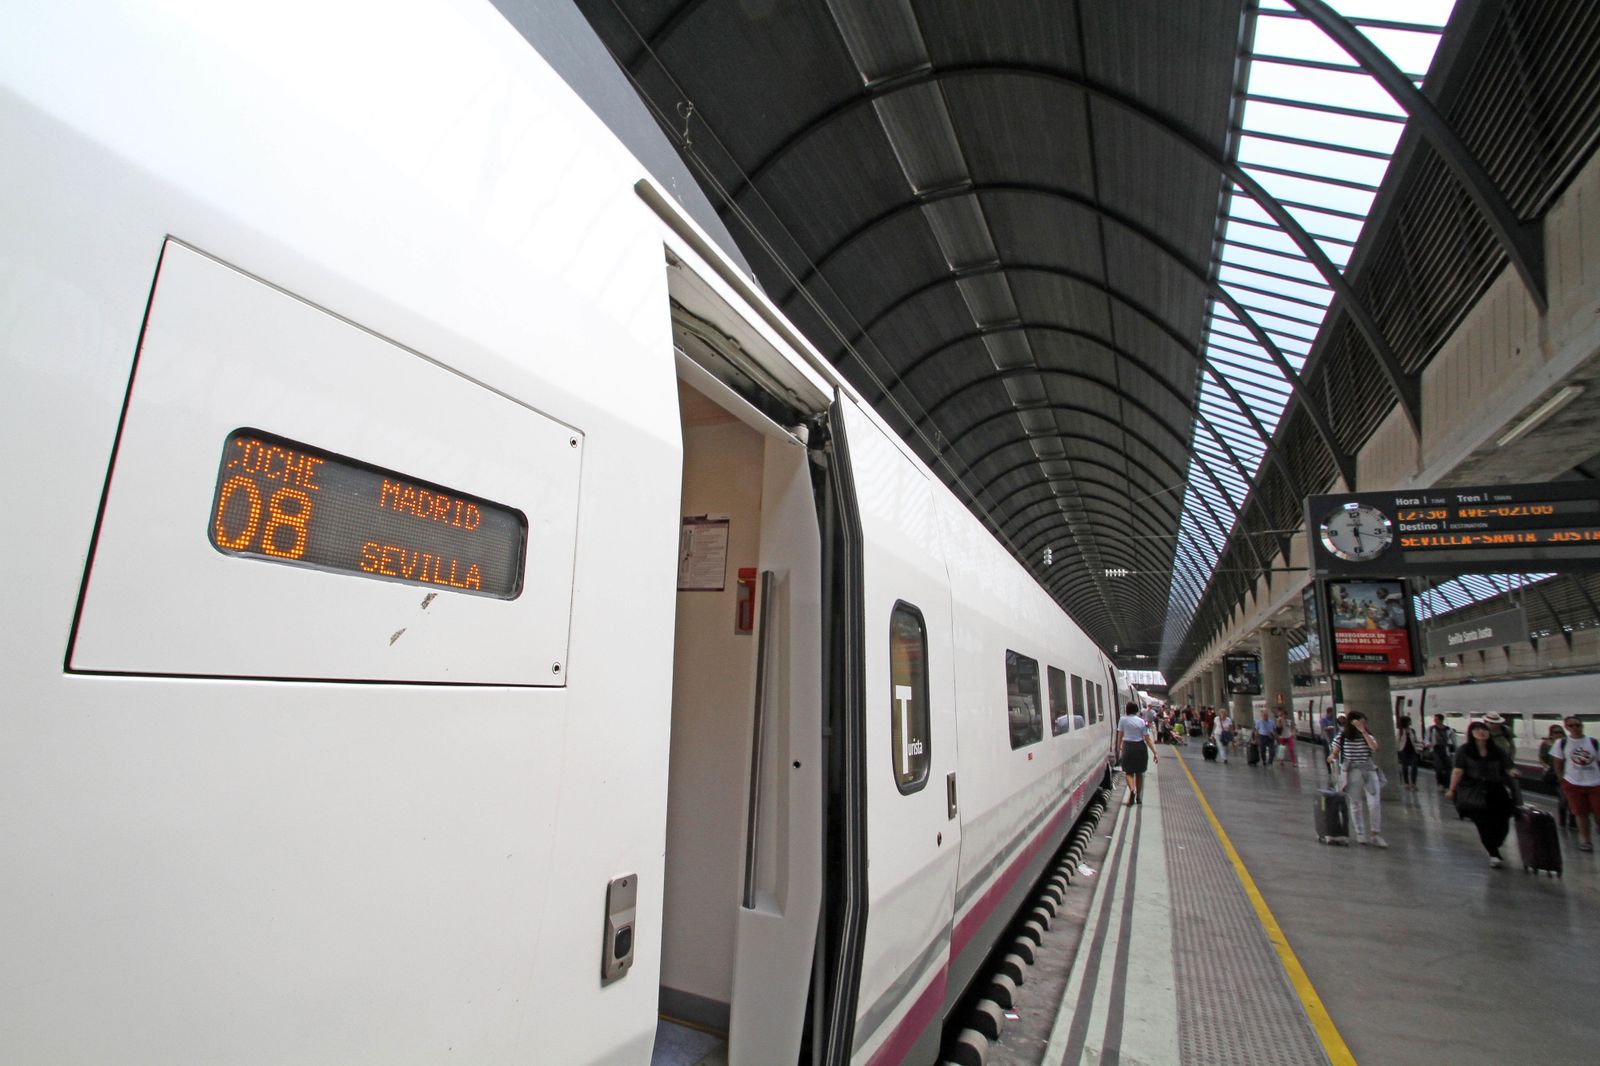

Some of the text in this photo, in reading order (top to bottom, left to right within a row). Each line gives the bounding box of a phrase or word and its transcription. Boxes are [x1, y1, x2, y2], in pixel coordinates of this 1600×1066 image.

[380, 479, 481, 531] MADRID
[1395, 498, 1420, 506] Hora
[1457, 494, 1480, 503] Tren
[216, 474, 312, 560] 08
[1399, 522, 1438, 531] Destino
[360, 541, 481, 591] SEVILLA
